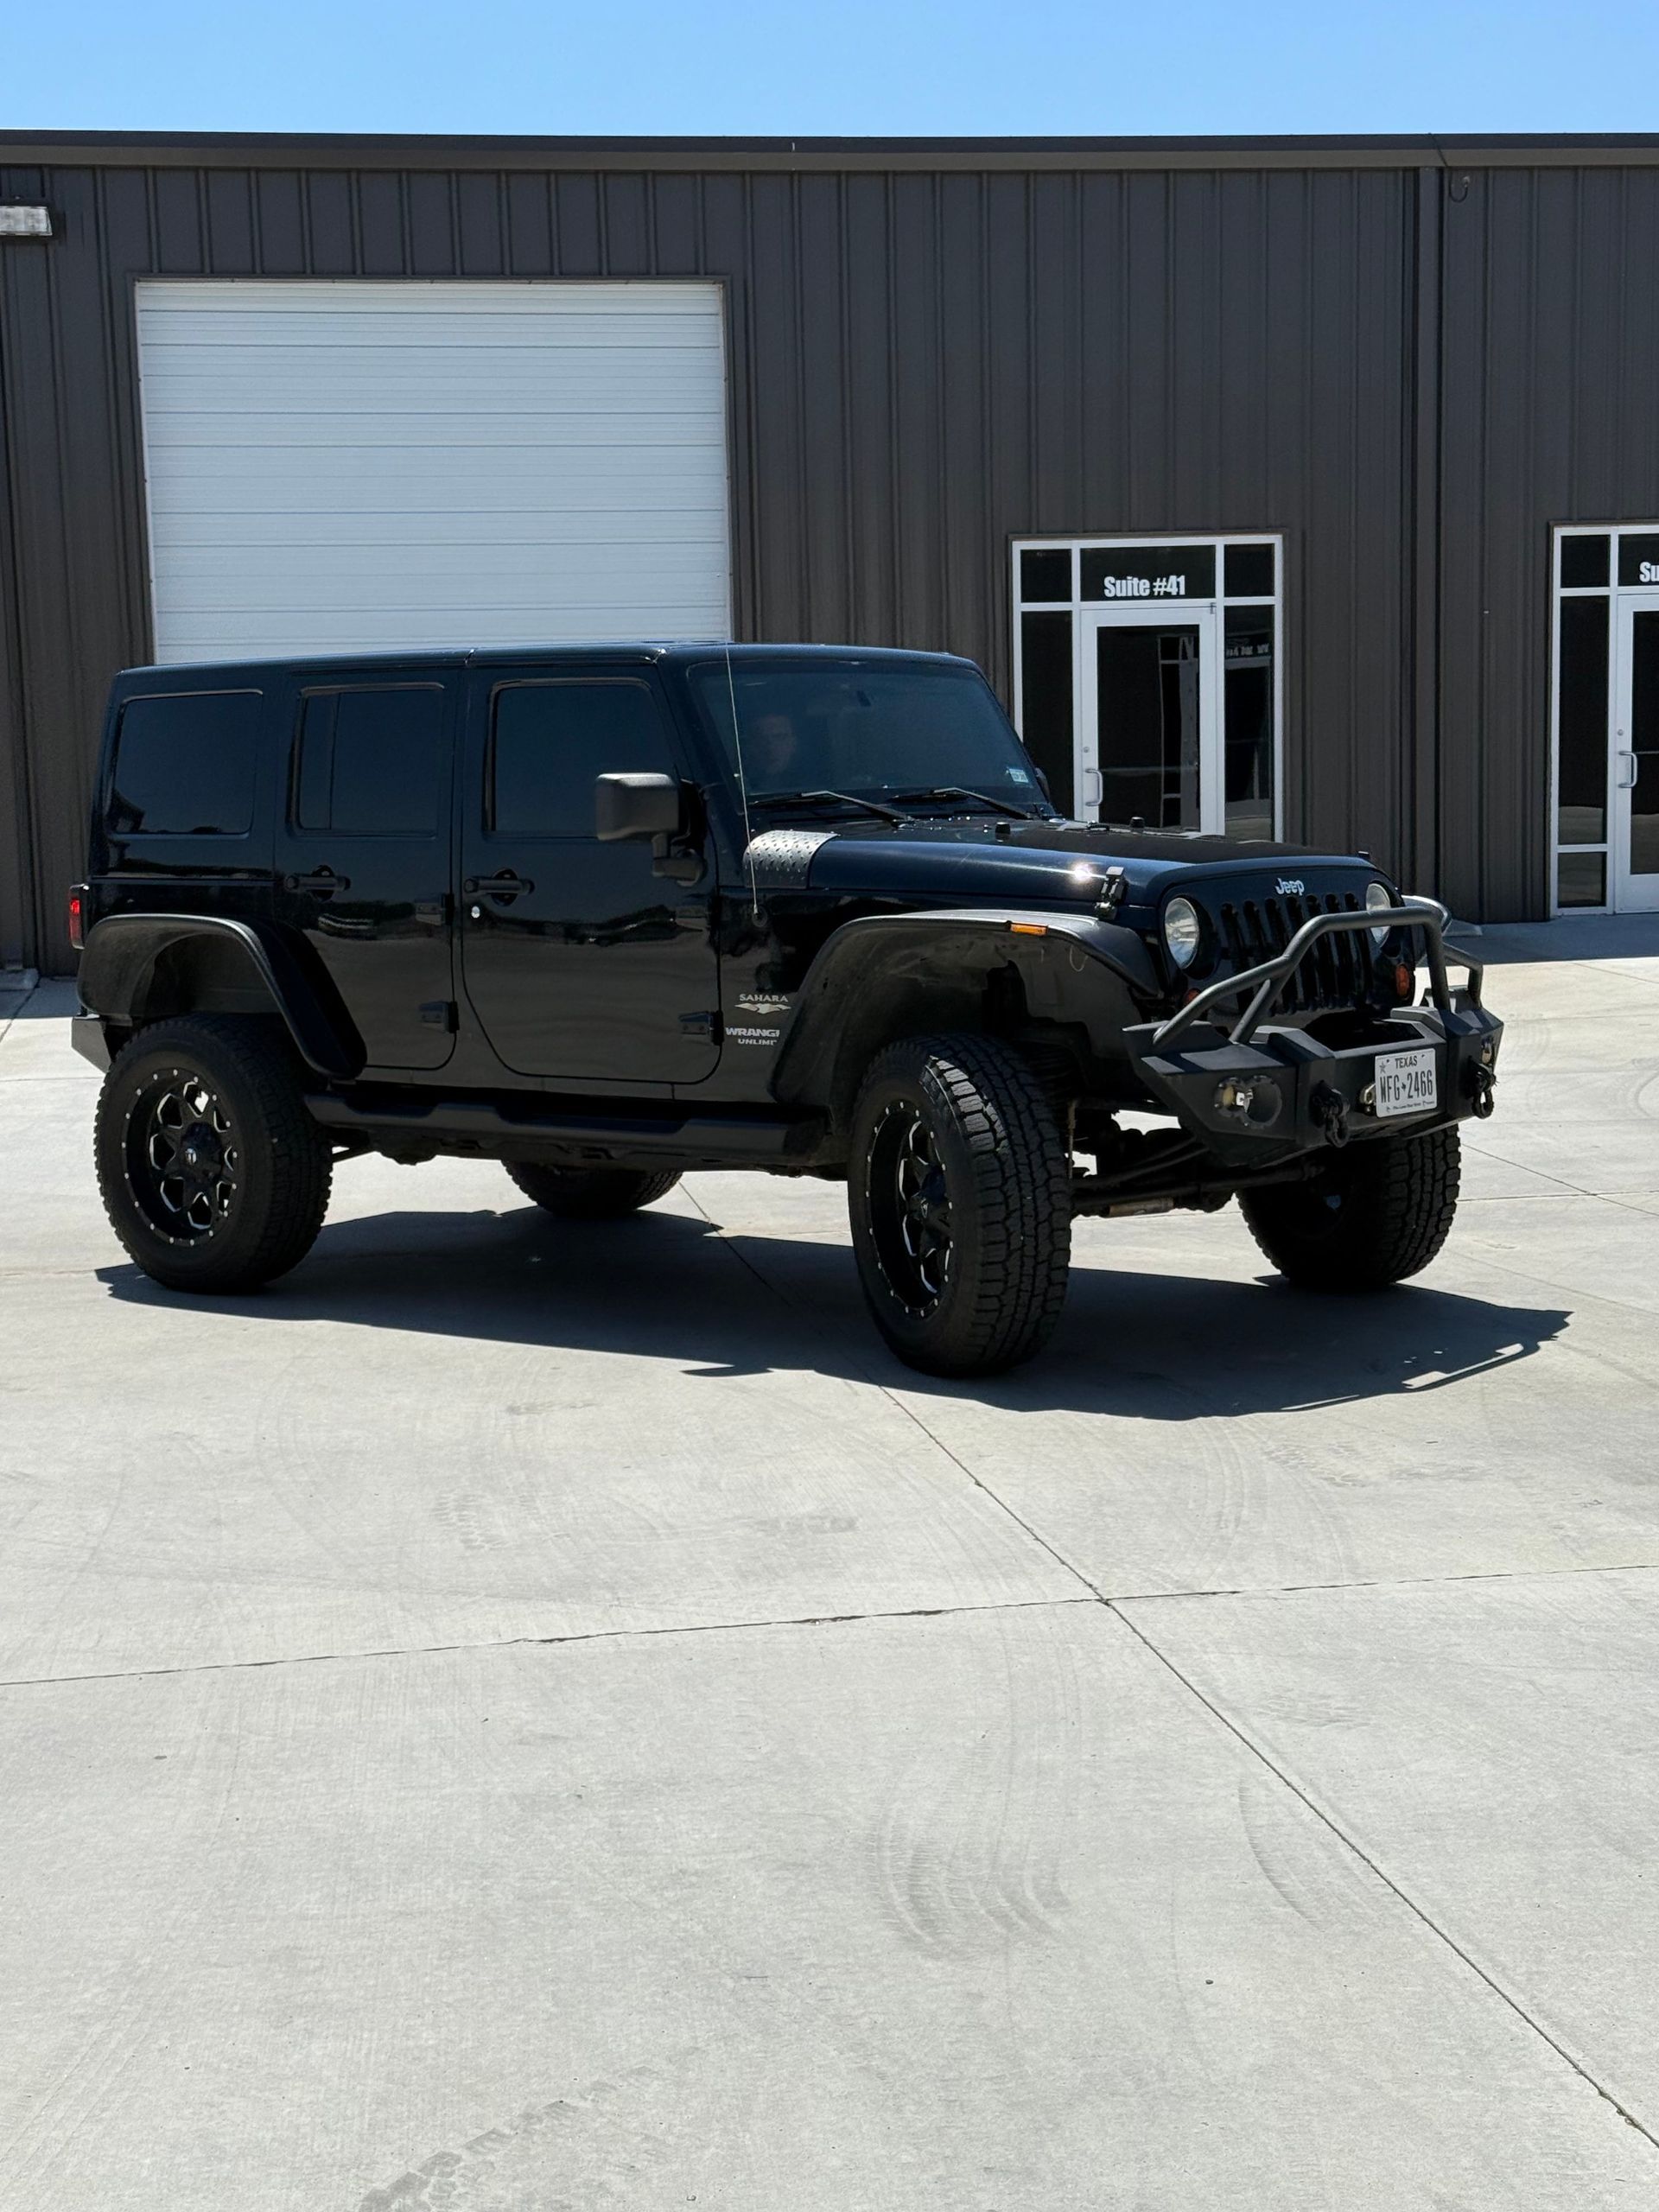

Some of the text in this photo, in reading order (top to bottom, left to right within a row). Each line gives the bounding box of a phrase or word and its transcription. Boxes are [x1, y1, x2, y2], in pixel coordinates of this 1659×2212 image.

[1103, 575, 1185, 597] Suite #41
[1274, 877, 1305, 896] Jeep
[739, 993, 789, 1002] SAHARA
[1395, 1055, 1418, 1070] TEXAS
